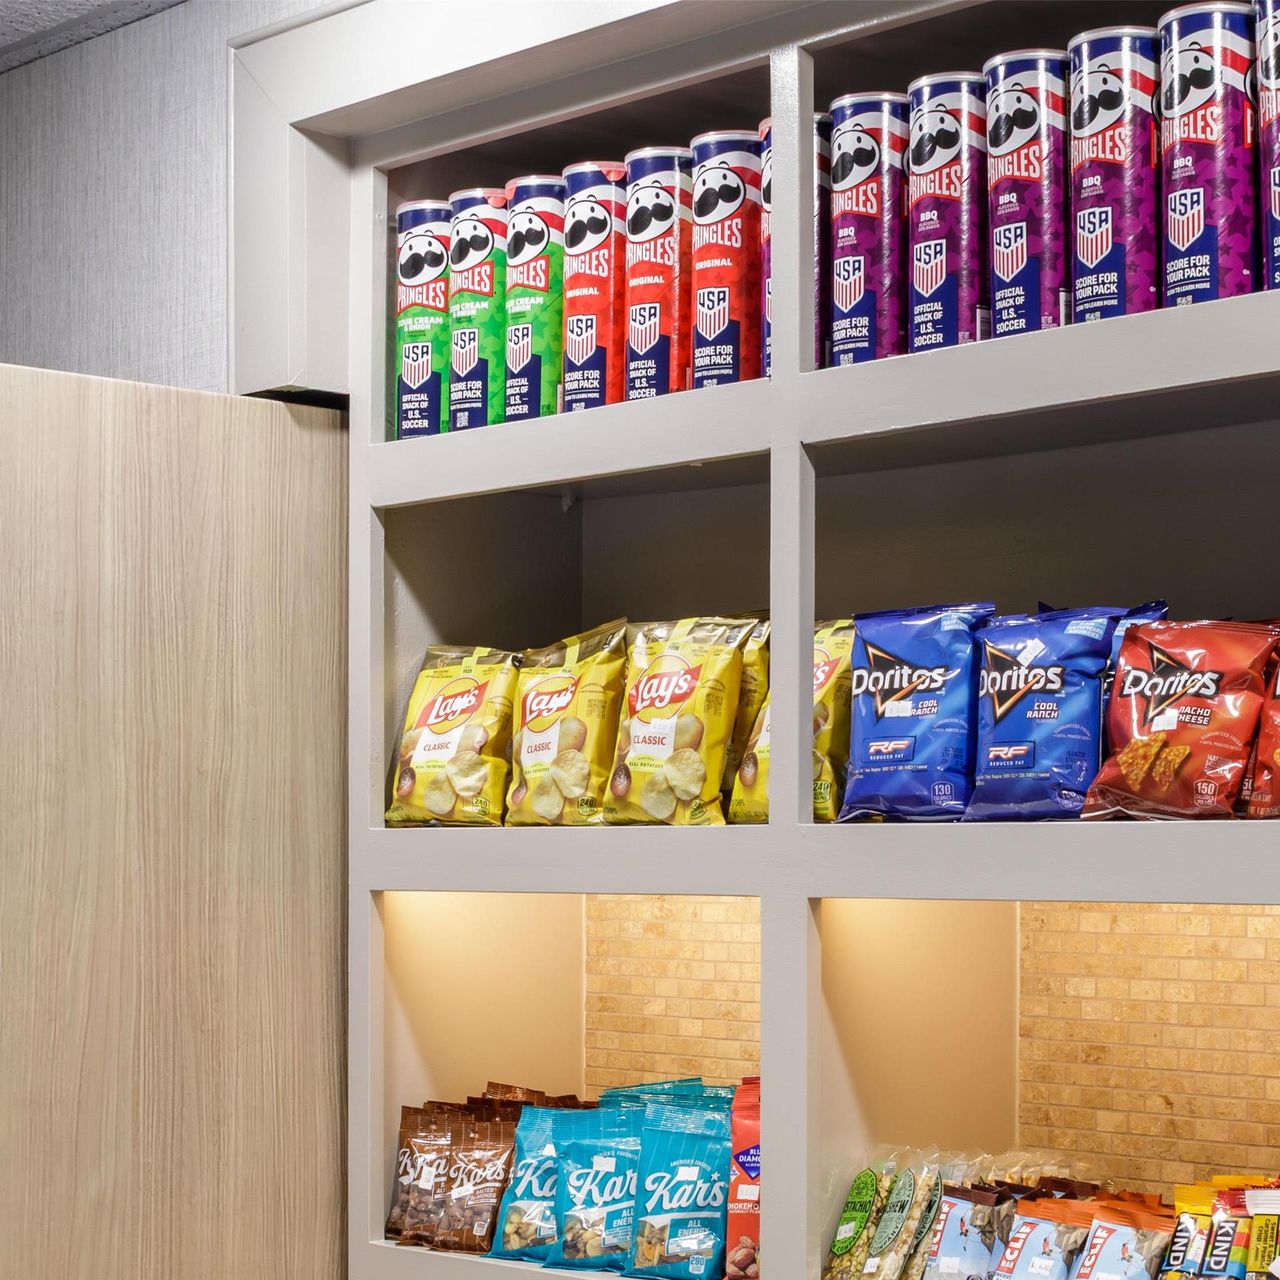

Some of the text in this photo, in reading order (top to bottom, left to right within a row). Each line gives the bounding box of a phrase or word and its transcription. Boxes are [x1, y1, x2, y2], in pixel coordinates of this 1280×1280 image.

[692, 219, 742, 250] PRINGLES
[995, 227, 1023, 248] USA
[696, 257, 732, 270] ORIGINAL
[1076, 273, 1117, 289] SCORE FOR
[1076, 283, 1117, 299] YOUR PACK
[398, 284, 445, 310] PRINGLES
[698, 290, 726, 309] USA
[404, 343, 429, 363] USA
[636, 667, 692, 707] Lay's
[853, 665, 945, 695] Doritos
[980, 665, 1062, 695] Doritos
[1125, 665, 1218, 699] Doritos
[428, 686, 479, 725] Lay's
[1027, 710, 1058, 719] RANCH
[1034, 703, 1057, 711] COOL
[423, 741, 451, 752] CLASSIC
[633, 735, 666, 746] CLASSIC
[1196, 783, 1215, 796] 150
[645, 1172, 725, 1213] Kar's
[687, 1220, 701, 1228] ALL
[1009, 1224, 1036, 1254] CLIF
[1085, 1227, 1110, 1265] CLIF
[1170, 1220, 1189, 1266] KIND
[1210, 1221, 1233, 1271] KIND
